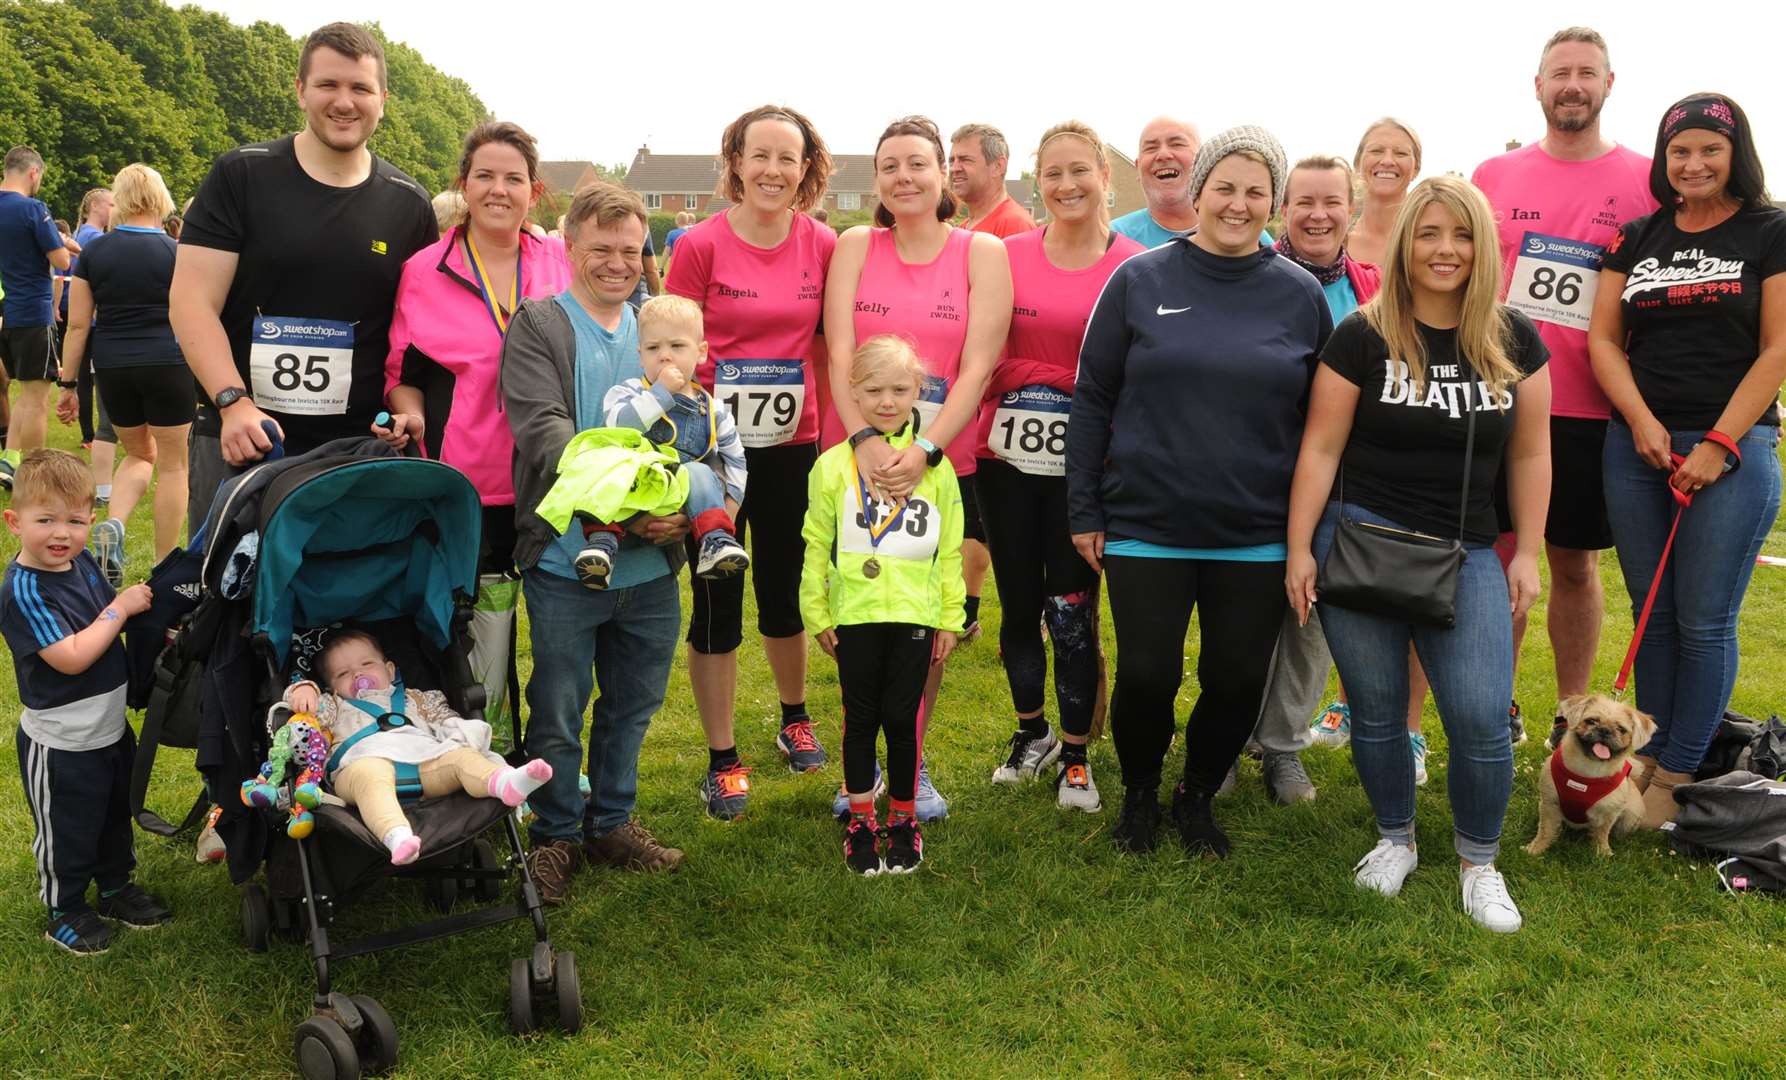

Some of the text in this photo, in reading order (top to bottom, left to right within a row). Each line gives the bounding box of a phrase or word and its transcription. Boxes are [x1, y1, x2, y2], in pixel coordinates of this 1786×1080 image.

[1511, 208, 1541, 220] Ian
[1598, 211, 1616, 220] RUN
[1672, 248, 1706, 261] REAL
[718, 286, 758, 298] Angela
[1528, 267, 1583, 306] 86
[855, 301, 890, 317] Kelly
[930, 312, 961, 321] IWADE
[283, 325, 347, 337] sweatshop.com
[272, 353, 330, 392] 85
[741, 365, 798, 375] sweatshop.com
[1430, 364, 1459, 378] THE
[723, 392, 796, 427] 179
[1001, 416, 1068, 456] 188
